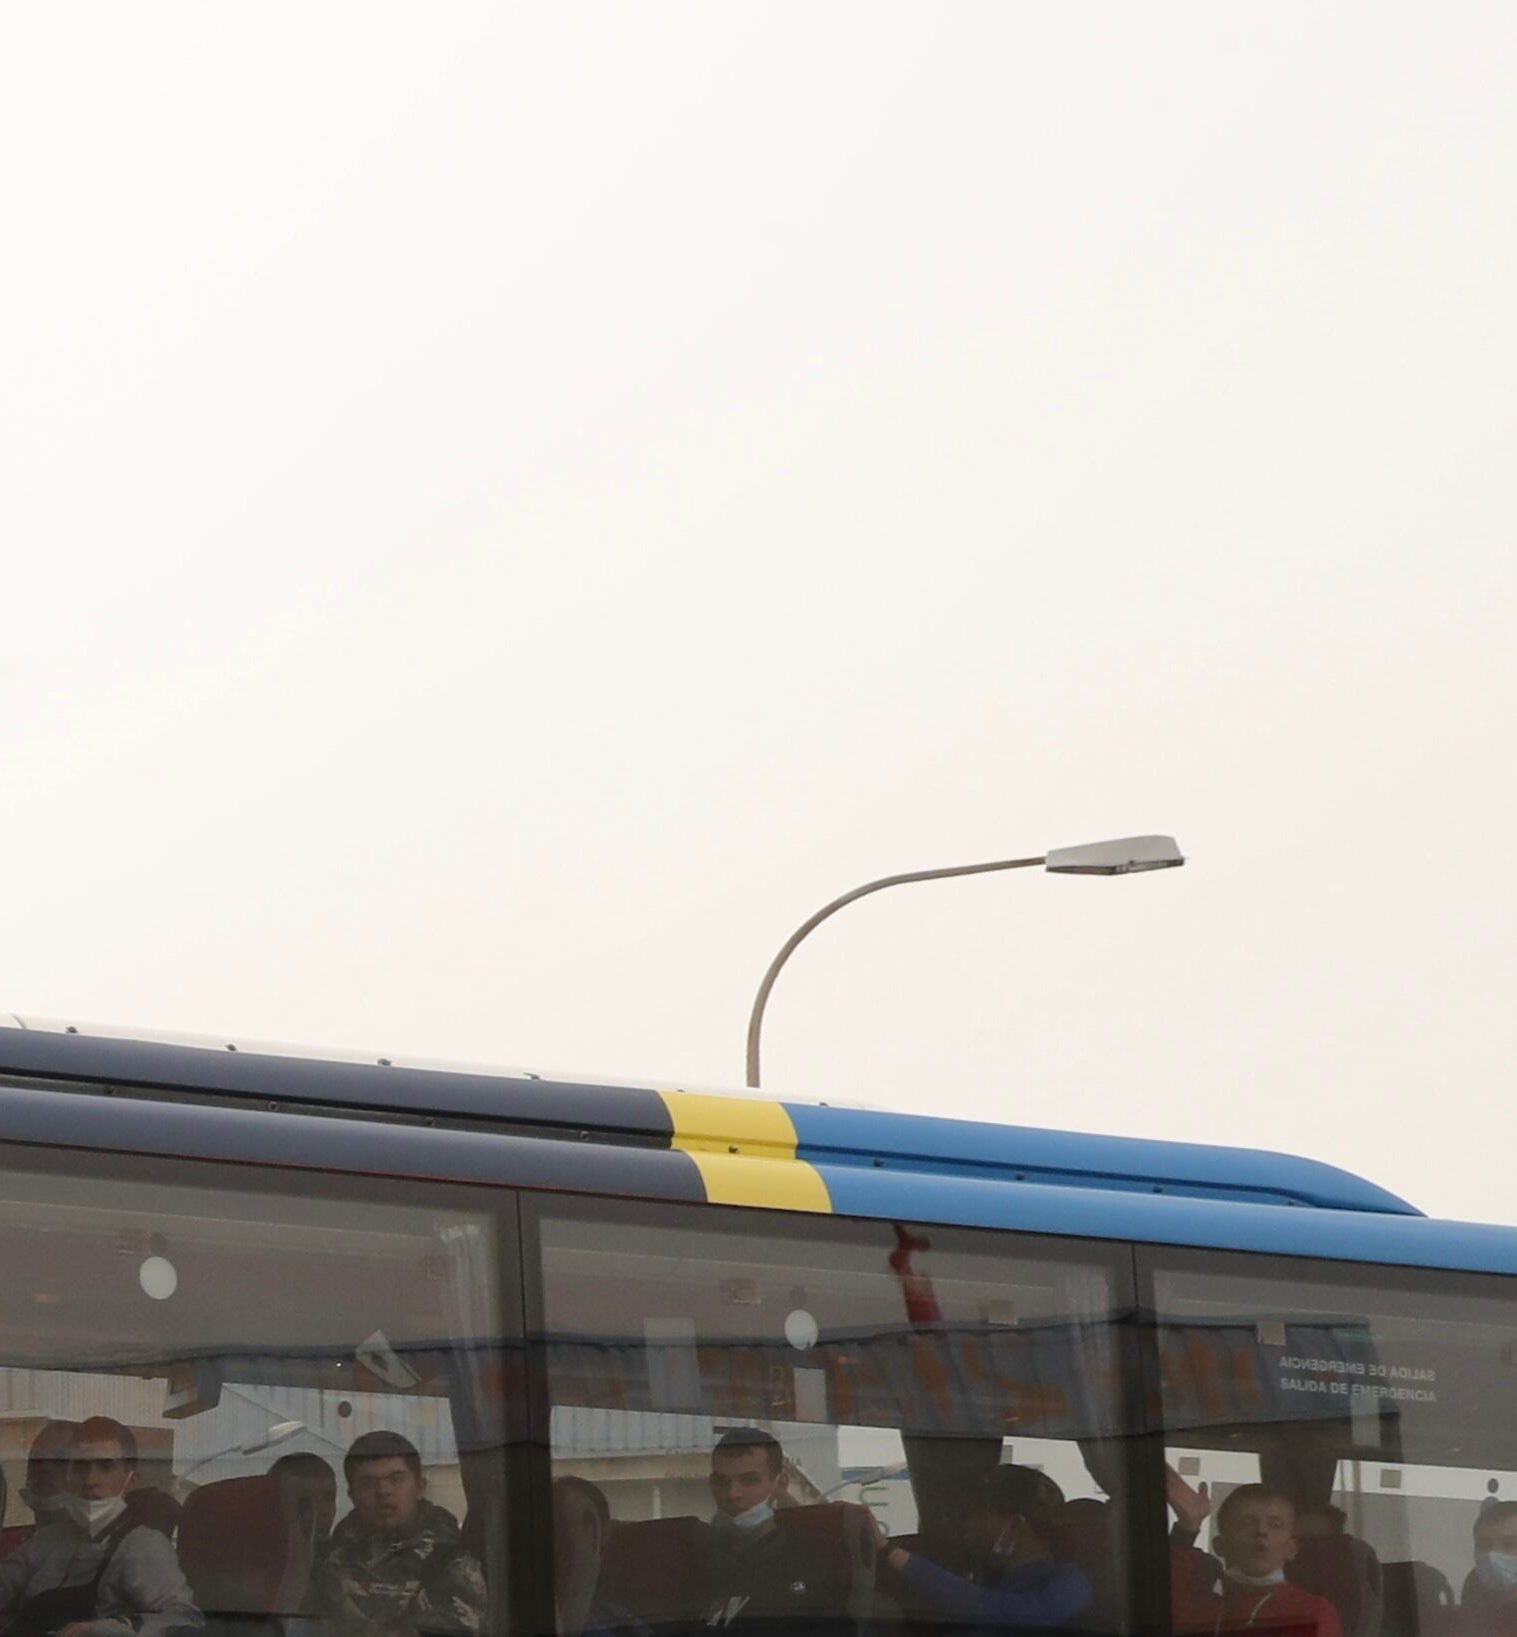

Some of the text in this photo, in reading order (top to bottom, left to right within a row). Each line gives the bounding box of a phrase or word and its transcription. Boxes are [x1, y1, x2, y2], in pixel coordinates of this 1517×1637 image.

[1279, 1377, 1437, 1403] SALIDA DE EMERGENCIA
